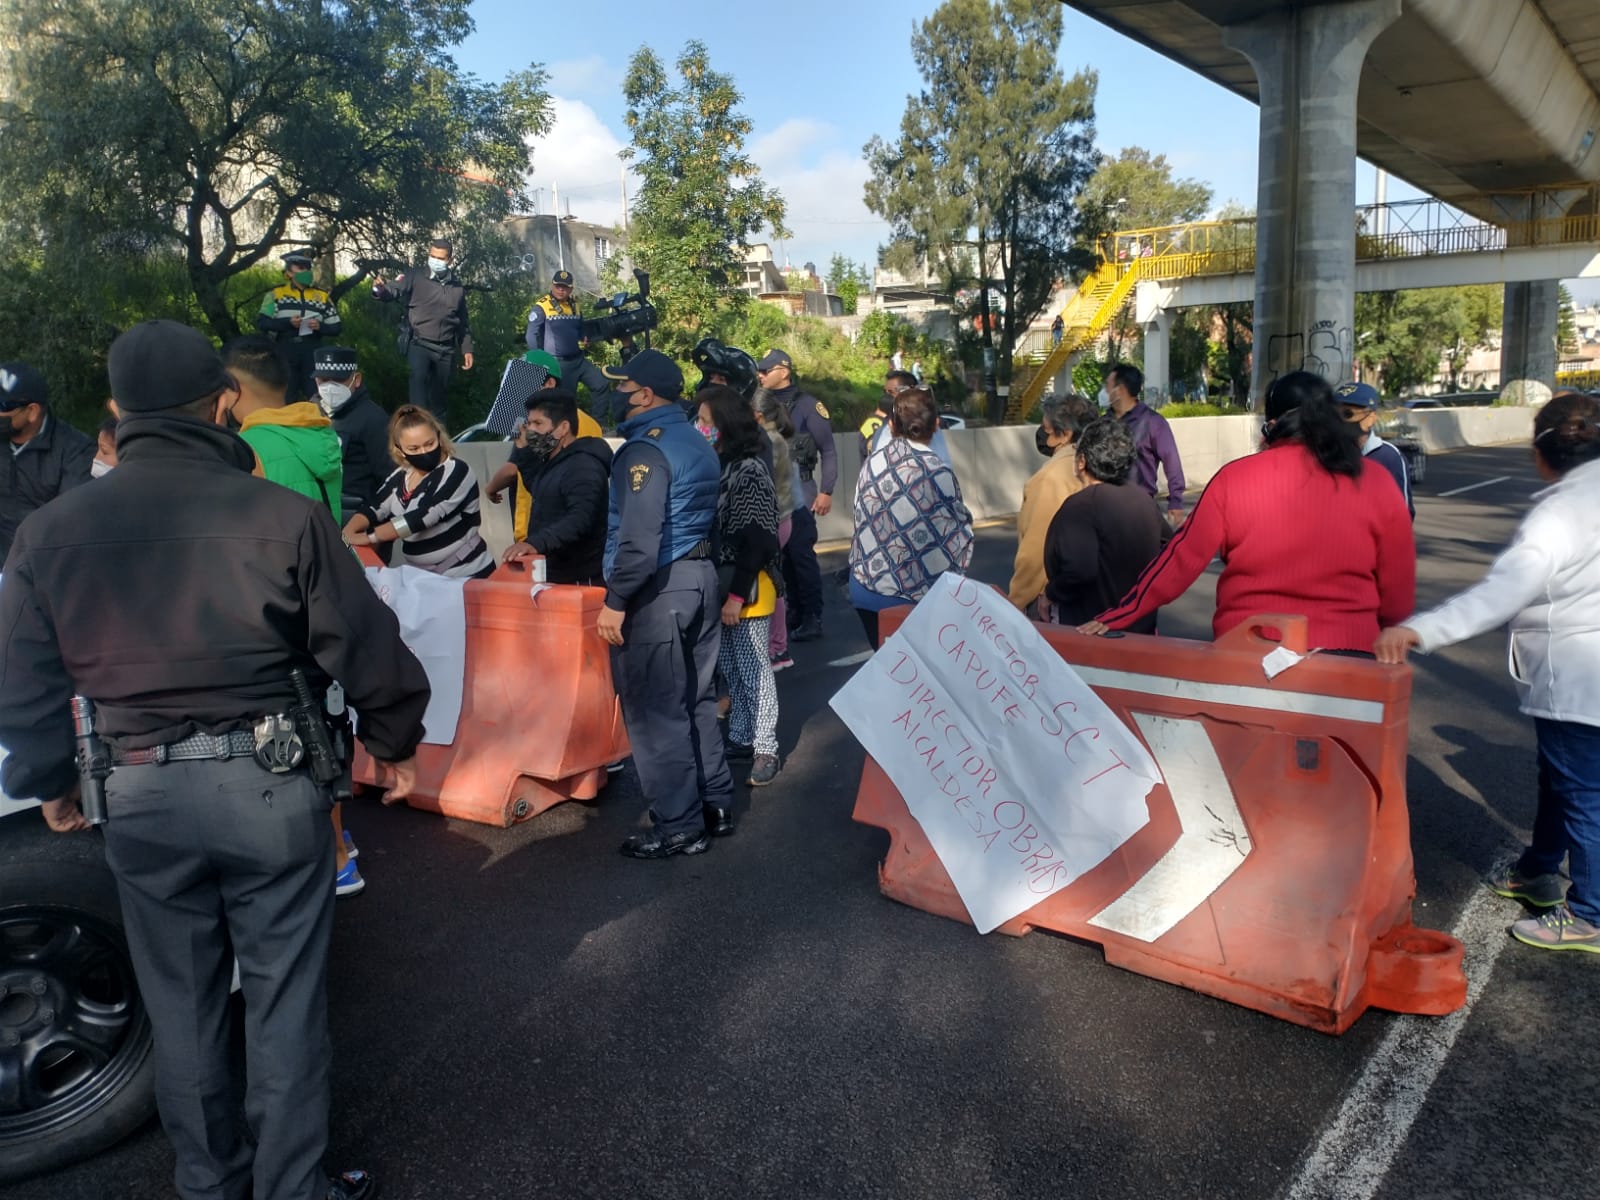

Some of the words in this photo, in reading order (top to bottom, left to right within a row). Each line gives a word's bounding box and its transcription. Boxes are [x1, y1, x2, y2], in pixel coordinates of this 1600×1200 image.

[886, 650, 998, 799] DIRECTOR
[993, 800, 1070, 894] OBRAS
[937, 623, 1027, 727] CAPUFE
[948, 576, 1039, 698] DIRECTOR
[1040, 700, 1131, 785] SCT
